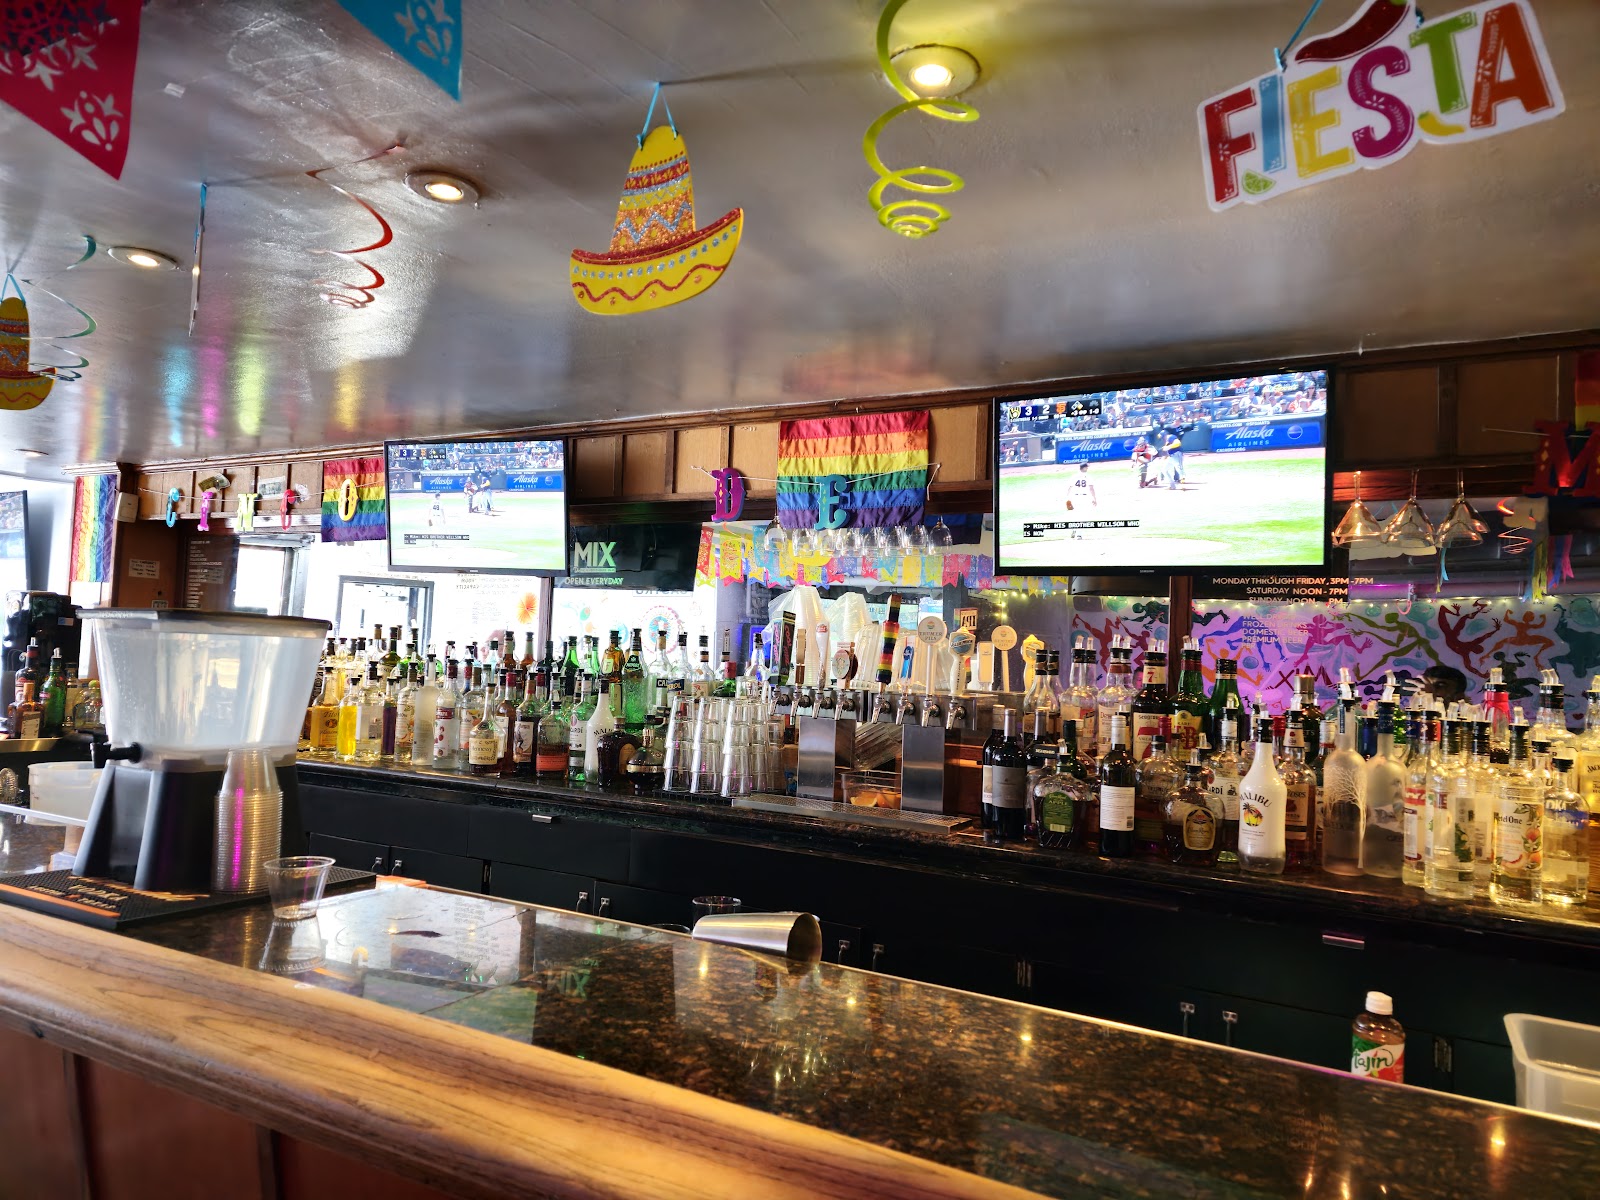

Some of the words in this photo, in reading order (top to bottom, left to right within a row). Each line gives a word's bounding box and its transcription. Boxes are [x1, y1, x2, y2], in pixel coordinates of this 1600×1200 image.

[1204, 3, 1554, 204] FIESTA
[1025, 406, 1032, 416] 3
[1043, 404, 1050, 414] 2
[1225, 425, 1274, 440] Alaska
[1071, 439, 1113, 452] Alaska
[429, 476, 453, 485] Alaska
[513, 474, 538, 483] Alaska
[574, 542, 617, 566] MIX
[565, 577, 584, 585] OPEN
[1213, 577, 1250, 585] MONDAY
[1251, 577, 1295, 585] THROUGH
[1330, 577, 1349, 585] 3PM
[1242, 620, 1276, 628] FROZEN
[1242, 635, 1280, 643] PREMIUM
[1147, 671, 1154, 682] 7
[1240, 791, 1272, 807] MALIBU
[1508, 815, 1522, 825] One
